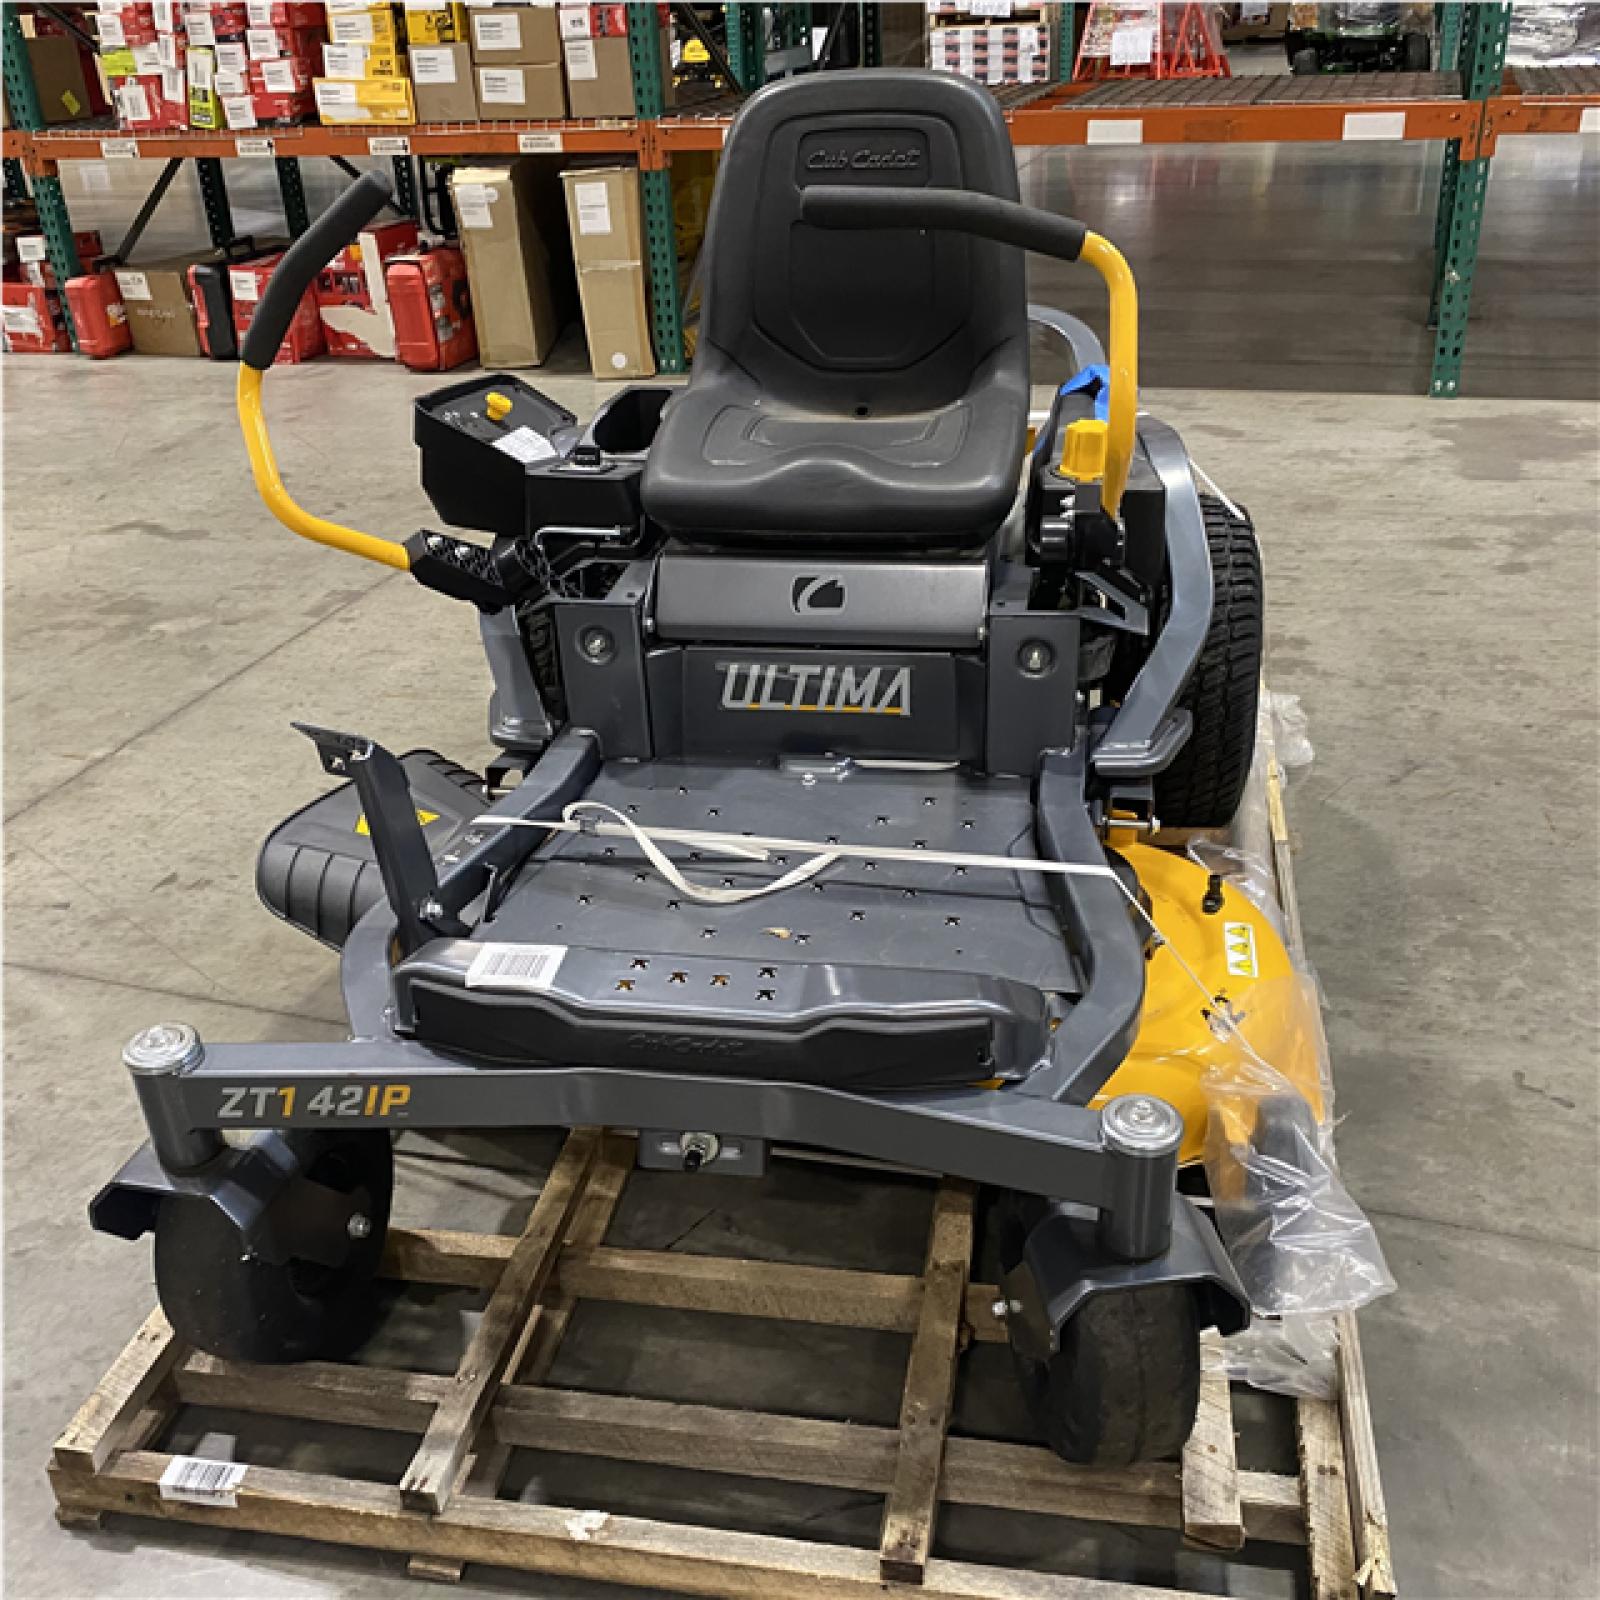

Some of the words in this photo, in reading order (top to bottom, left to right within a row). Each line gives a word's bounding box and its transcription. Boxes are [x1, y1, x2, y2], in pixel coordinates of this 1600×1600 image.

[808, 149, 848, 169] Cub
[720, 664, 911, 716] ULTIMA
[217, 1086, 297, 1119] ZT1
[307, 1084, 412, 1117] 42IP
